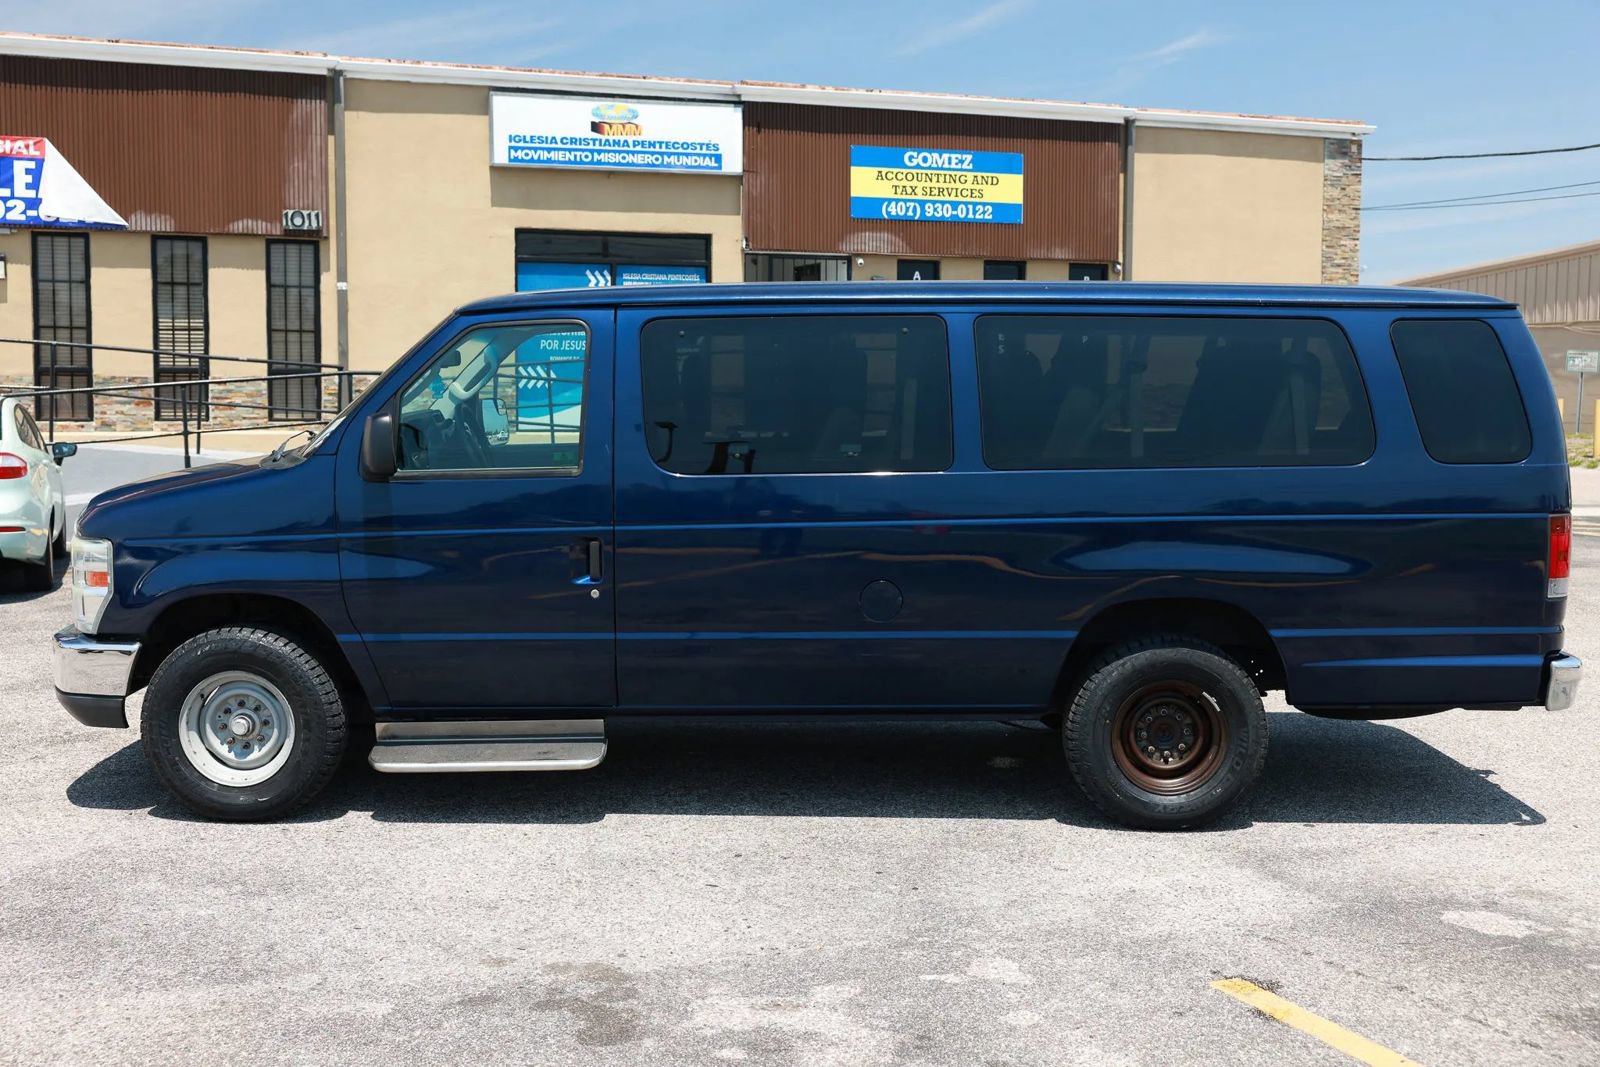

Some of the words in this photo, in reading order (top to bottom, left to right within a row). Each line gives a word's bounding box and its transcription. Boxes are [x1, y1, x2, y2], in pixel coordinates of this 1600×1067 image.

[603, 122, 642, 137] MMM
[508, 134, 558, 145] IGLESIA
[560, 137, 630, 148] CRISTIANA
[632, 140, 719, 151] PENTECOSTÉS
[510, 148, 592, 161] MOVIMIENTO
[593, 151, 662, 164] MISIONERO
[663, 154, 718, 166] MUNDIAL
[903, 151, 973, 169] GOMEZ
[876, 170, 968, 184] ACCOUNTING
[971, 175, 1000, 186] AND
[892, 185, 918, 196] TAX
[921, 186, 984, 199] SERVICES
[881, 201, 921, 220] (407)
[925, 203, 993, 219] 930-0122
[284, 211, 320, 228] 1011
[540, 339, 560, 350] POR
